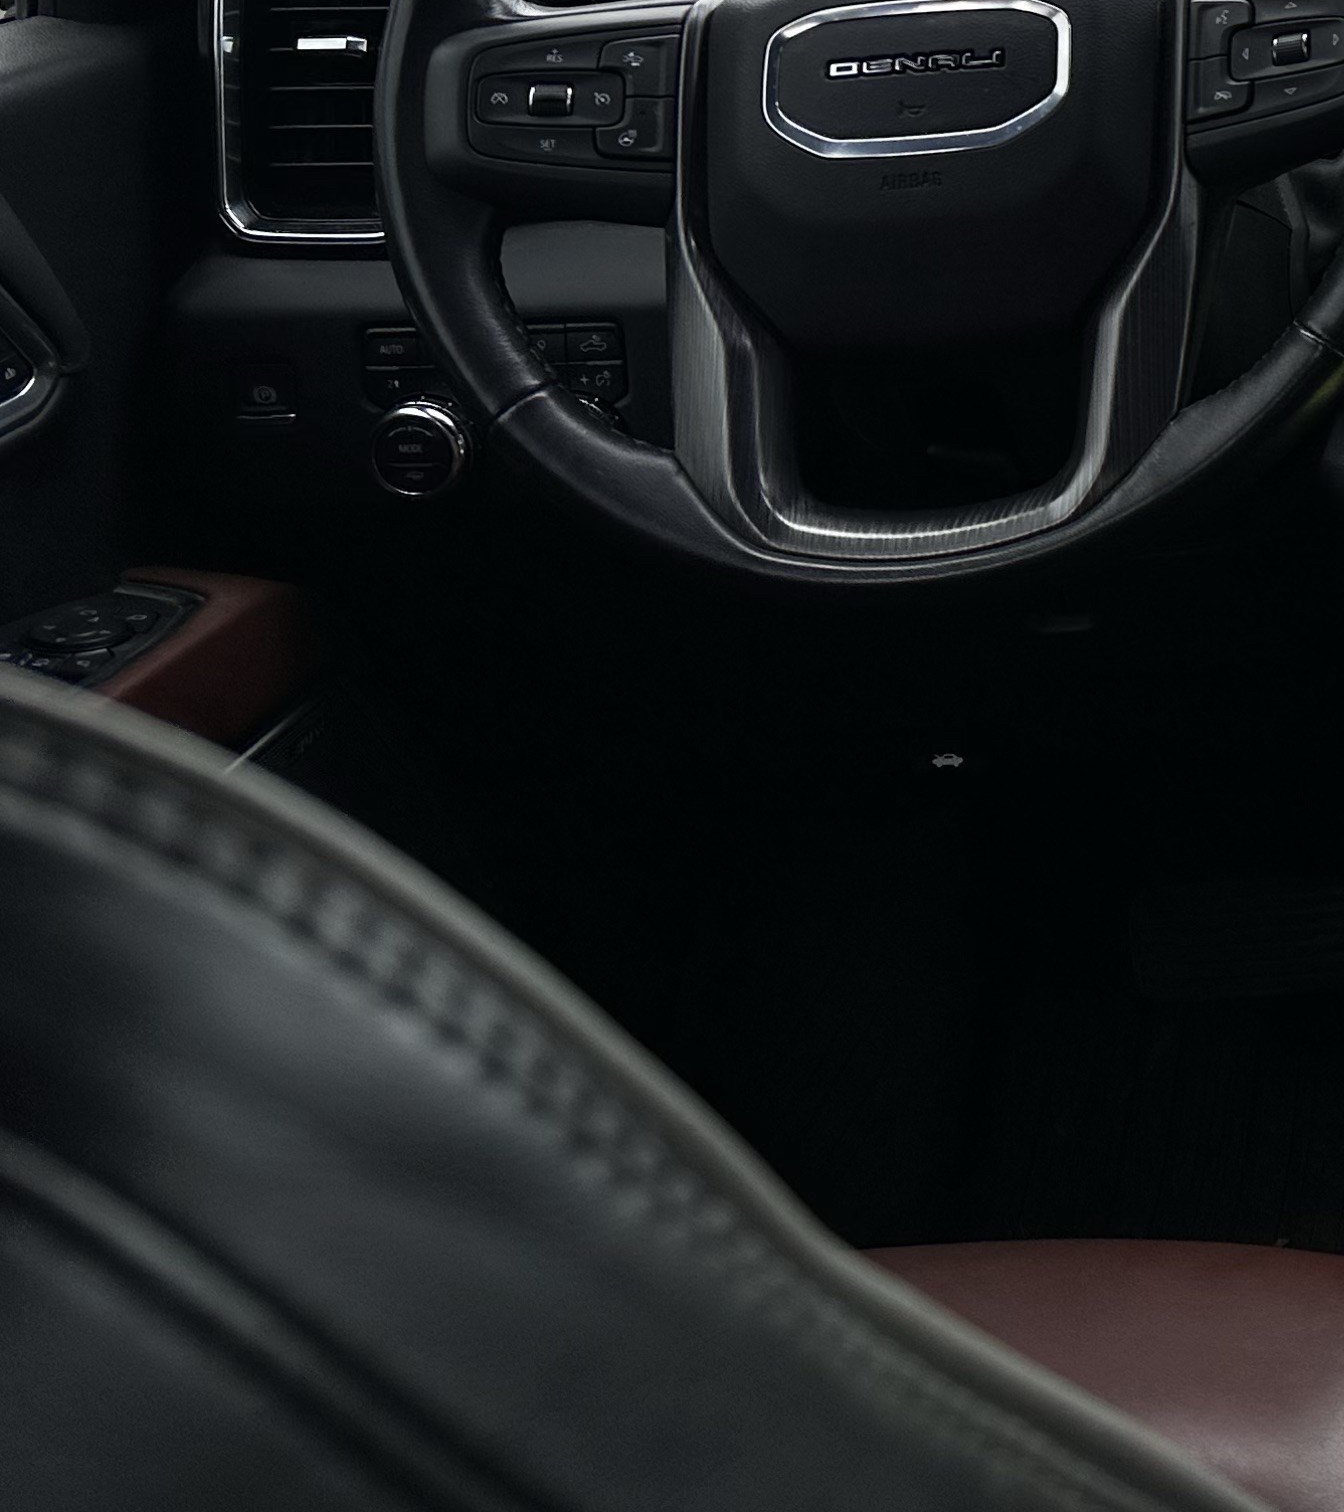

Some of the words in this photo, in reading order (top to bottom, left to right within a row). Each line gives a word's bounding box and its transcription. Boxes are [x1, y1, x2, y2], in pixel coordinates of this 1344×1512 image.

[829, 50, 1002, 78] DENALI
[879, 170, 943, 191] AIRBAG
[379, 345, 405, 356] AUTO
